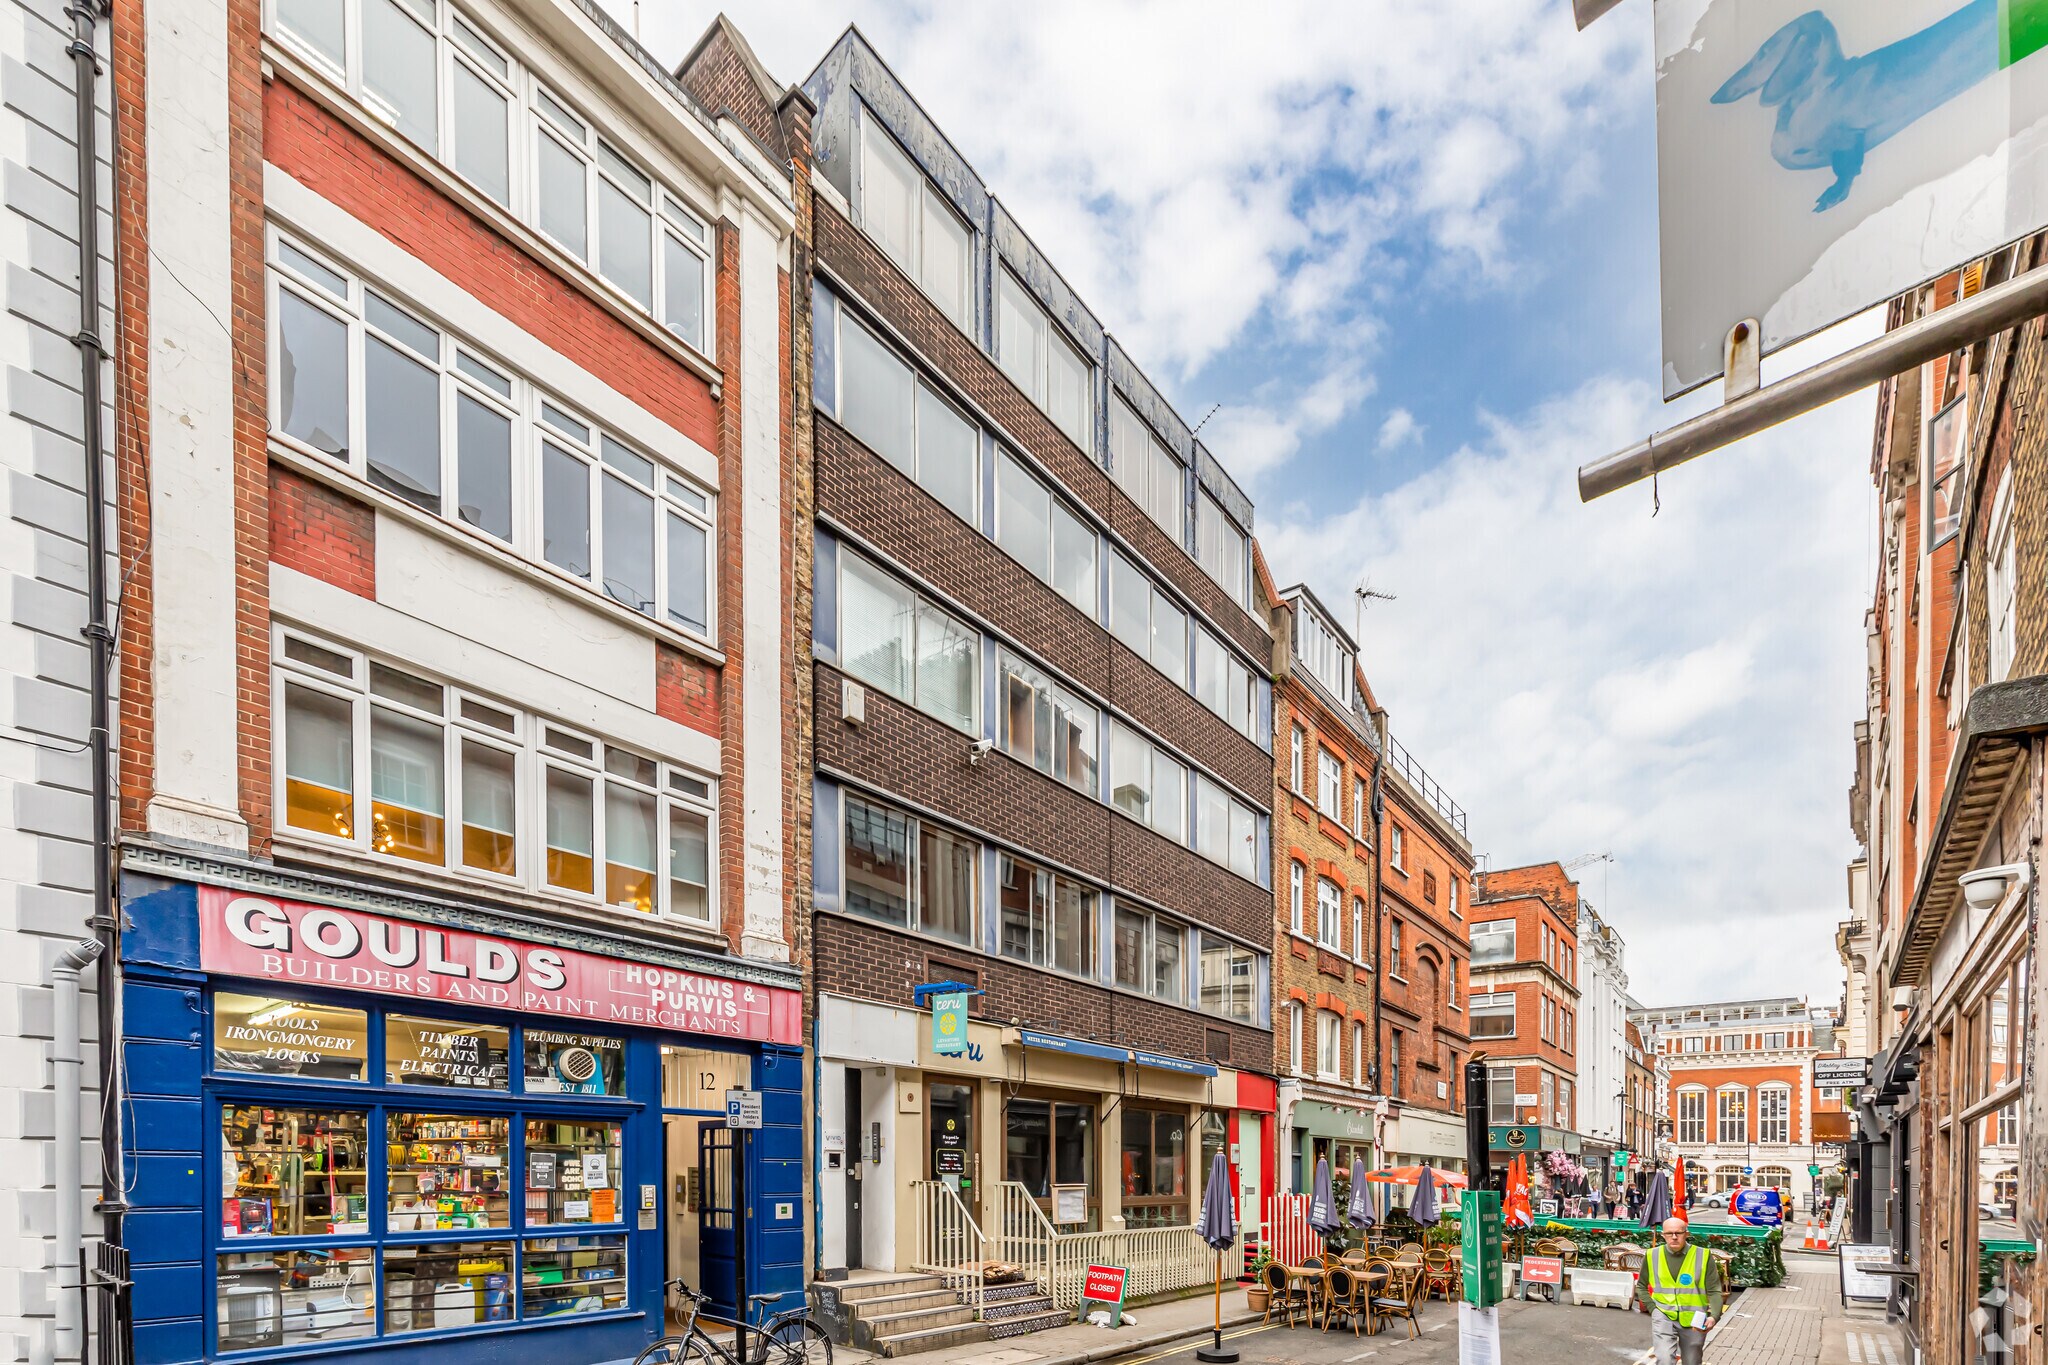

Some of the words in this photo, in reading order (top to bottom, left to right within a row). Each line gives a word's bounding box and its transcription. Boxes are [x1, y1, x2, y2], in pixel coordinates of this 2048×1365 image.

[224, 897, 566, 991] GOULDS
[626, 964, 734, 998] HOPKINS
[743, 985, 755, 1003] &
[261, 954, 431, 993] BUILDERS
[446, 980, 509, 1004] AND
[524, 991, 599, 1015] PAINT
[609, 1003, 740, 1034] MERCHANTS
[652, 989, 737, 1017] PURVIS
[268, 1014, 320, 1031] TOOLS
[225, 1025, 356, 1050] IRONGMONGERY
[419, 1031, 478, 1047] TIMBER
[528, 1031, 577, 1045] PLUMBING
[580, 1036, 621, 1049] SUPPLIES
[265, 1047, 321, 1064] LOCKS
[420, 1046, 478, 1062] PAINTS
[400, 1059, 496, 1078] ELECTRICAL
[558, 1082, 577, 1092] EST
[581, 1083, 596, 1094] 1811
[699, 1072, 716, 1091] 12
[730, 1102, 739, 1114] P
[561, 1175, 584, 1183] SOHO
[1524, 1259, 1559, 1267] PEDESTRIANS
[1088, 1271, 1122, 1281] FOOTPATH
[1090, 1282, 1115, 1293] CLOSED
